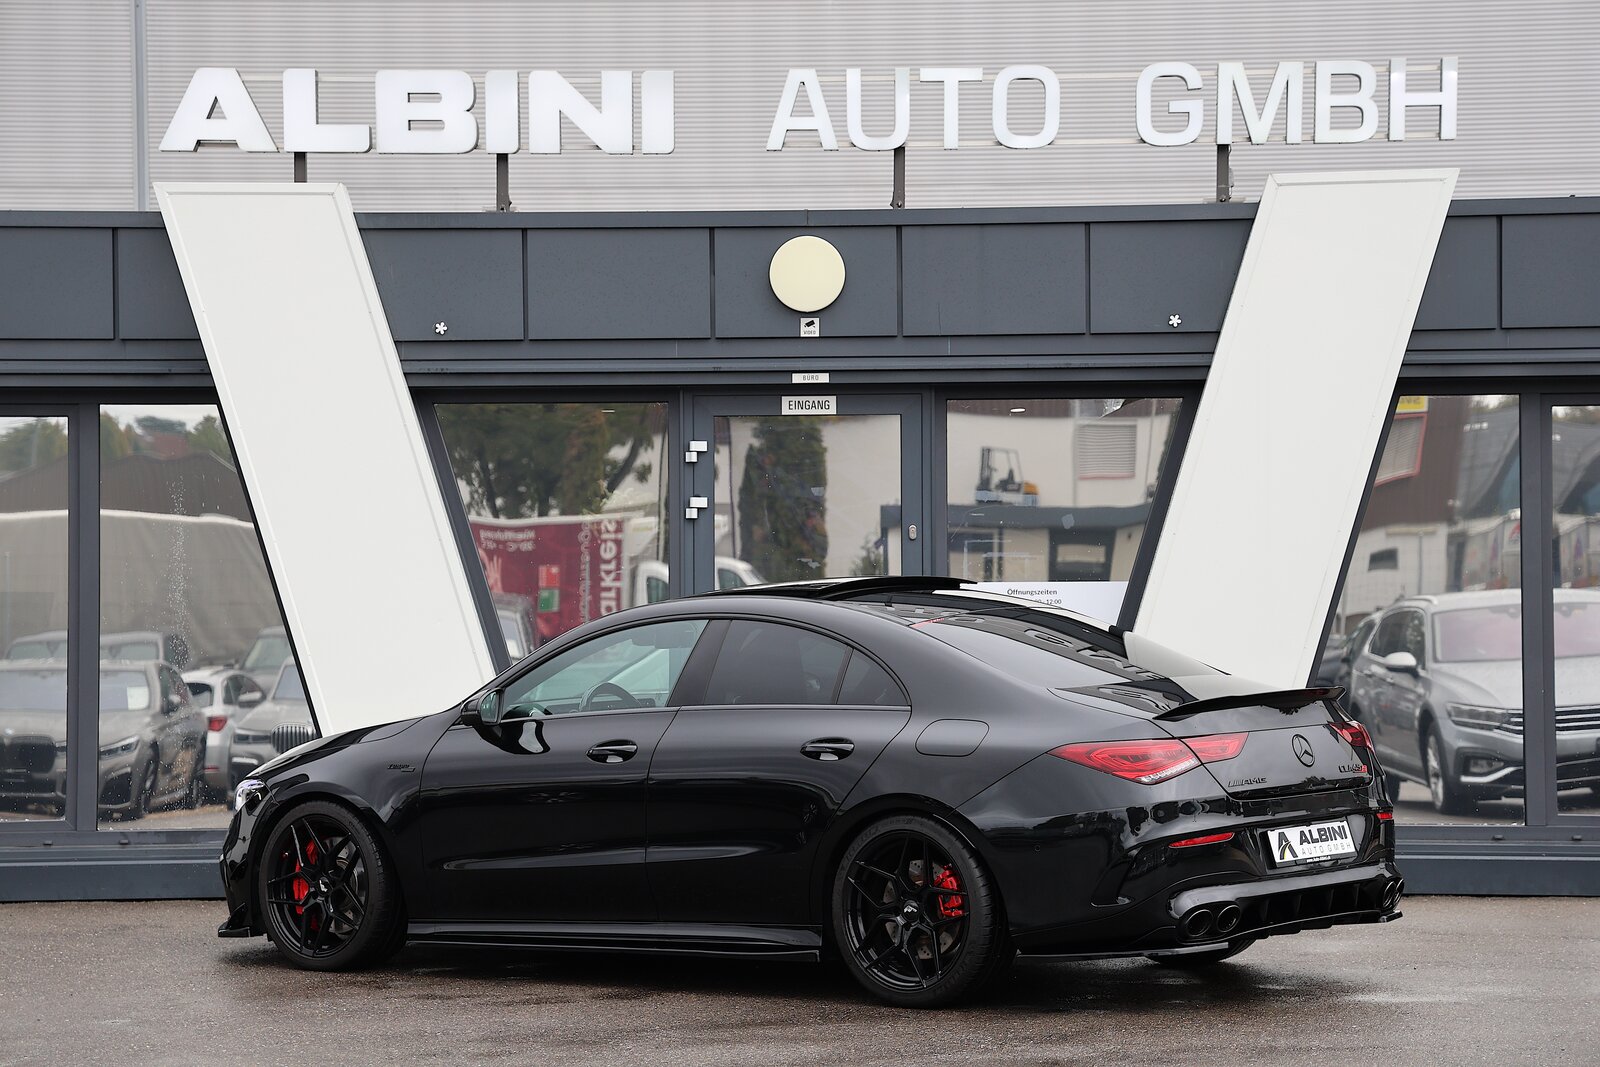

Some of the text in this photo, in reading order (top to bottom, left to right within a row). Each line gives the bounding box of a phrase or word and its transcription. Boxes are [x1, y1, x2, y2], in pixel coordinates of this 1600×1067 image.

[158, 56, 1459, 155] ALBINI AUTO GMBH
[788, 399, 831, 411] EINGANG
[1007, 588, 1058, 596] Öffnungszeiten
[1299, 825, 1348, 845] ALBINI
[1301, 842, 1351, 856] AUTO GMBH
